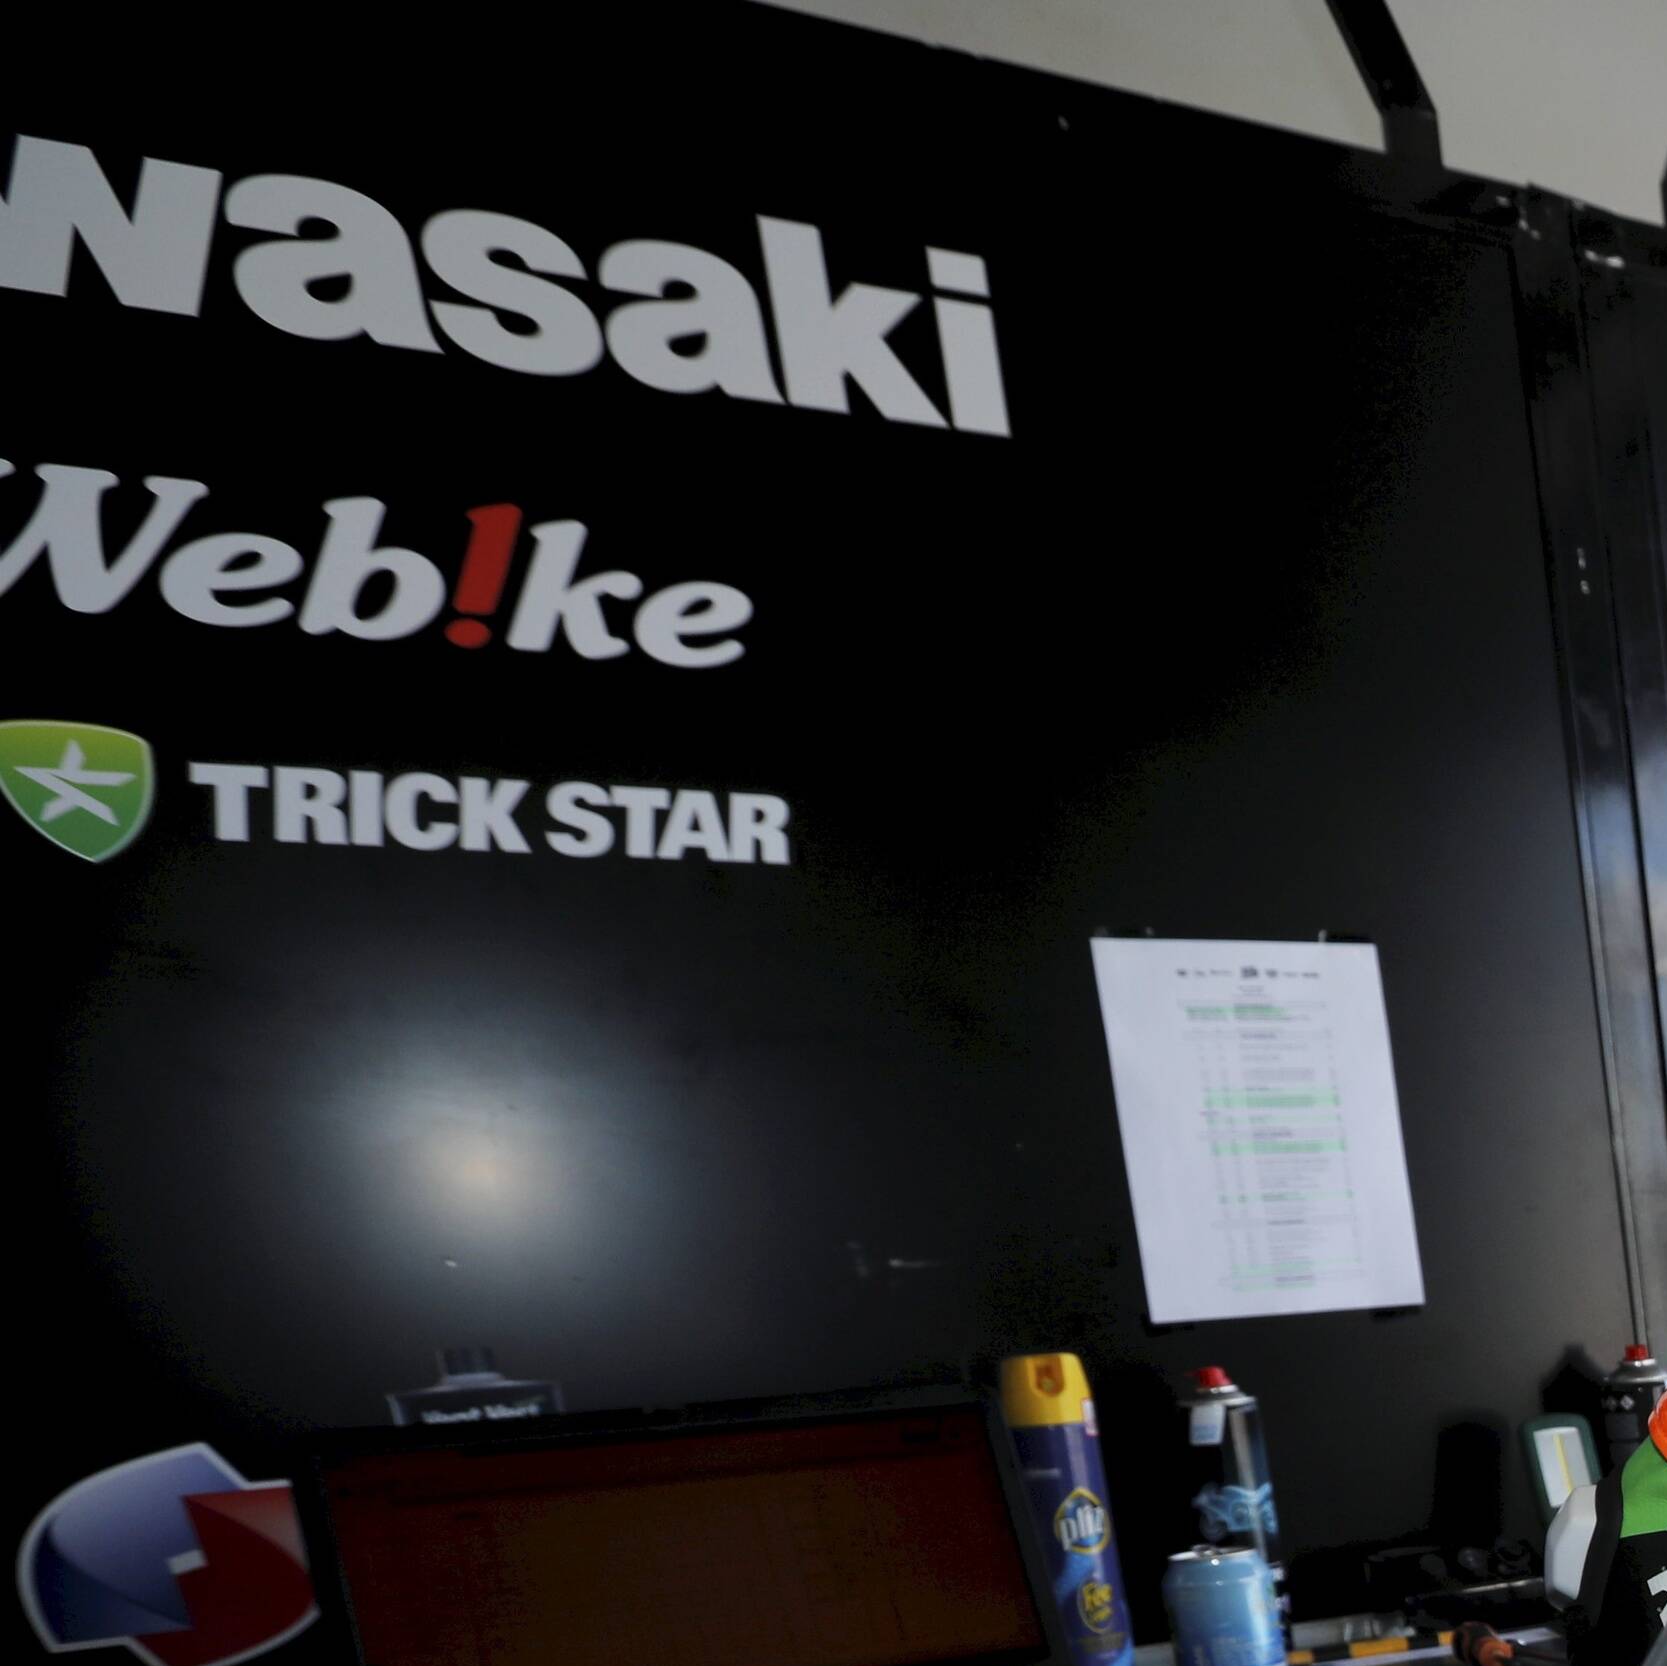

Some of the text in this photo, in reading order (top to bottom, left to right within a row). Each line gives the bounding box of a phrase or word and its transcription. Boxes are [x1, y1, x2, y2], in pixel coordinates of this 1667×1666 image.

[0, 134, 1011, 438] wasaki
[189, 761, 790, 864] TRICK STAR
